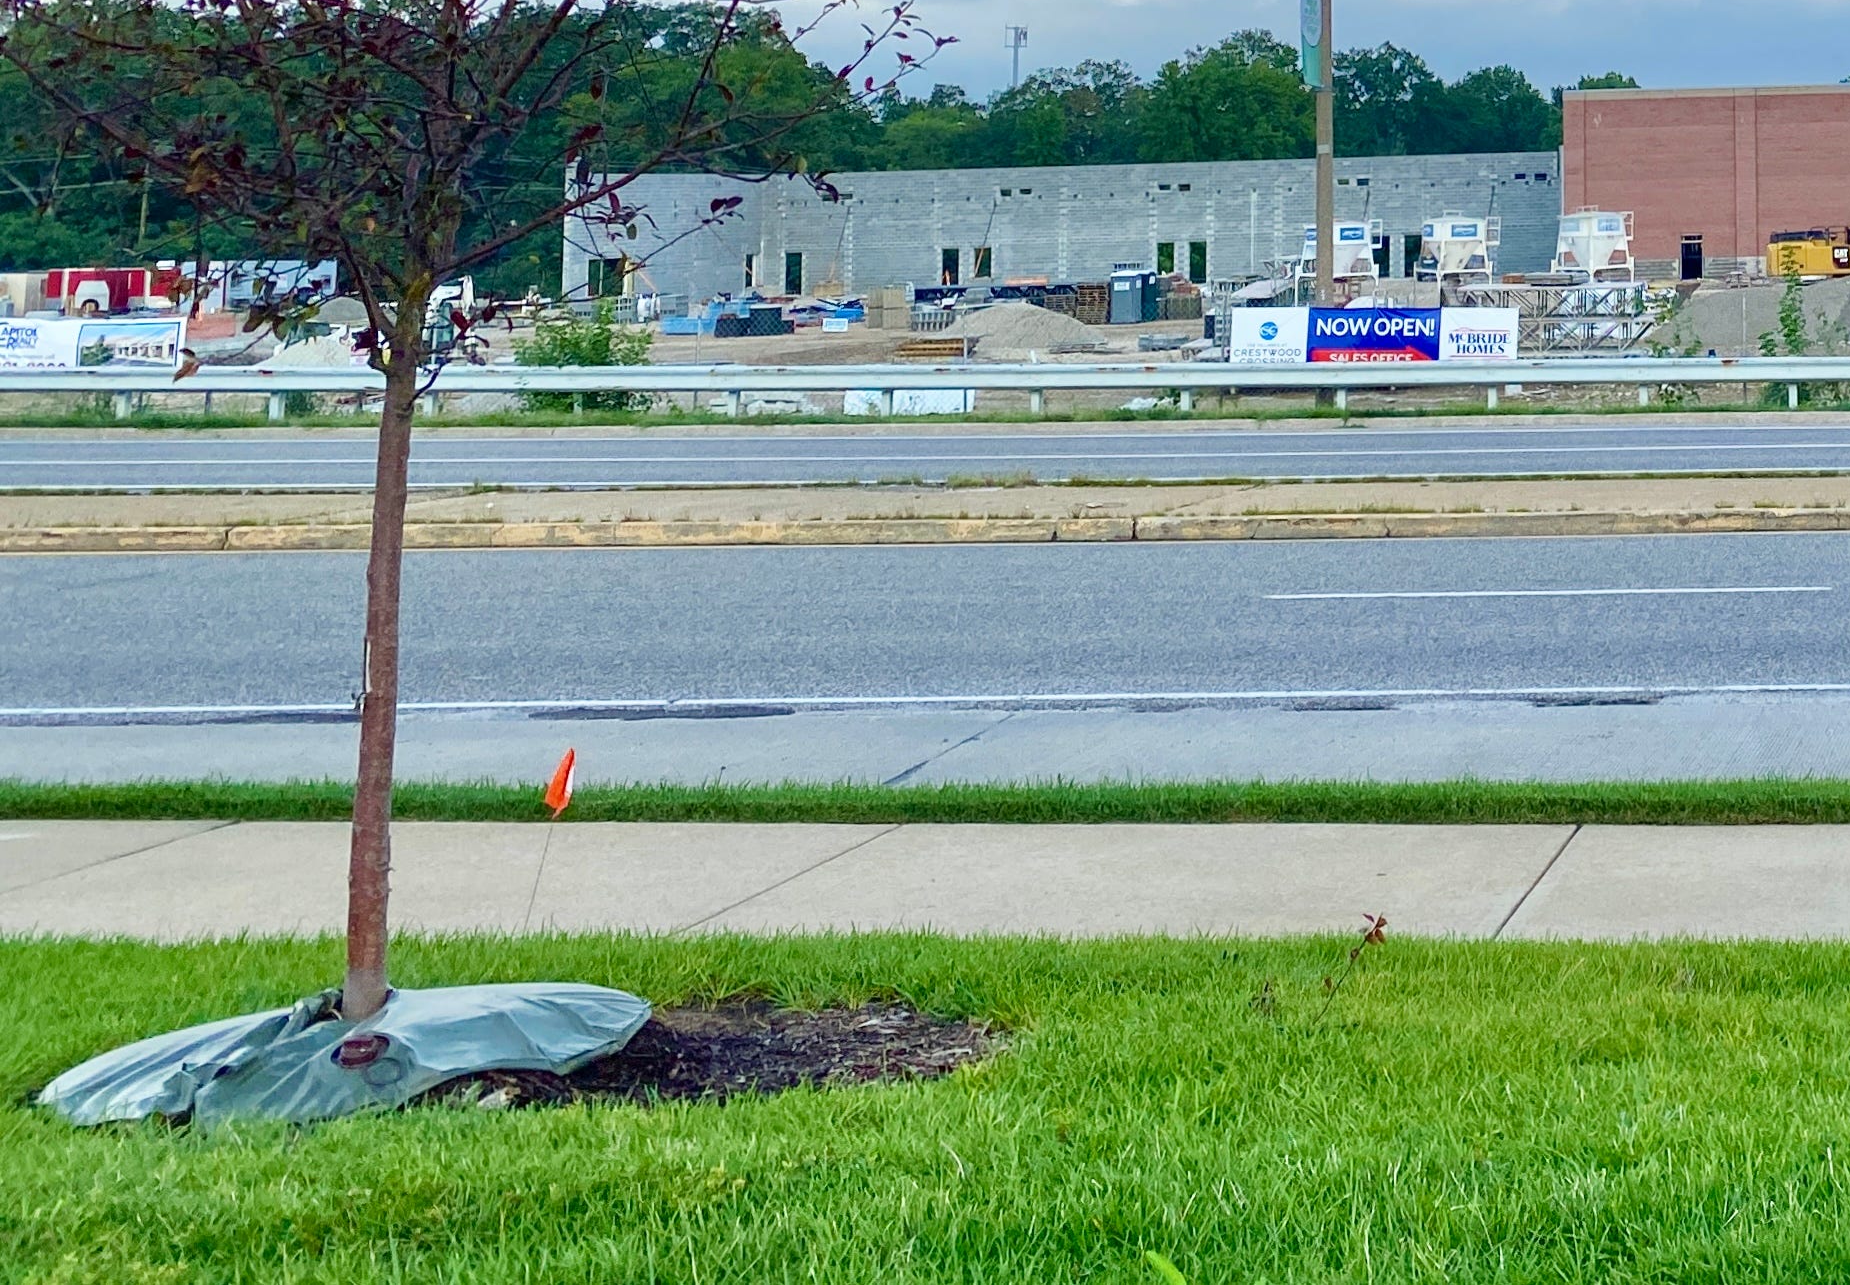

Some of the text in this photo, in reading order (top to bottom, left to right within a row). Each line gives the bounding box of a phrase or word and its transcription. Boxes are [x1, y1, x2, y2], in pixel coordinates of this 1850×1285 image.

[1834, 248, 1849, 259] CAT
[1316, 317, 1435, 337] NOW OPEN!
[1233, 348, 1302, 357] CRESTWOOD
[1456, 344, 1505, 354] HOMES
[1329, 353, 1414, 362] SALES OFFICE
